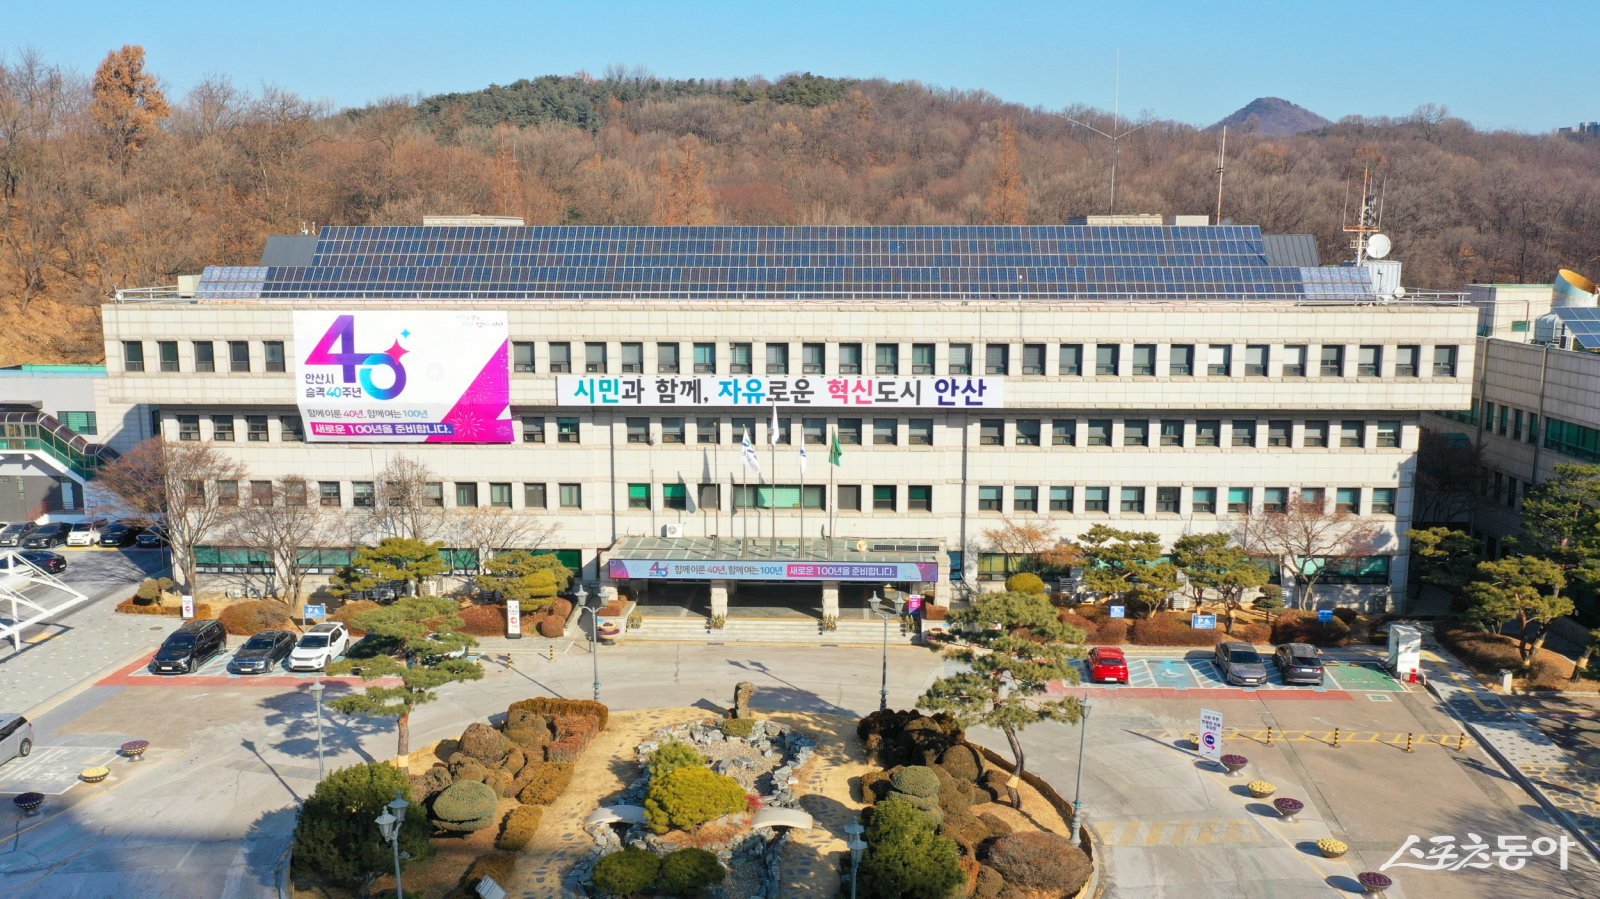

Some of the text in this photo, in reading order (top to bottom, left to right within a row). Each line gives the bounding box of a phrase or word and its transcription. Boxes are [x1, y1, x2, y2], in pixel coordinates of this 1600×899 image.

[305, 373, 335, 385] 안산시
[574, 378, 988, 406] 시민과 함께, 자유로운 혁신도시 안산
[343, 409, 366, 419] 40년,
[403, 409, 428, 419] 100년
[315, 423, 452, 434] 새로운 100년을 준비합니다.
[760, 565, 783, 575] 100년
[789, 566, 814, 576] 새로운
[816, 566, 850, 576] 100년을
[851, 566, 895, 577] 준비합니다.
